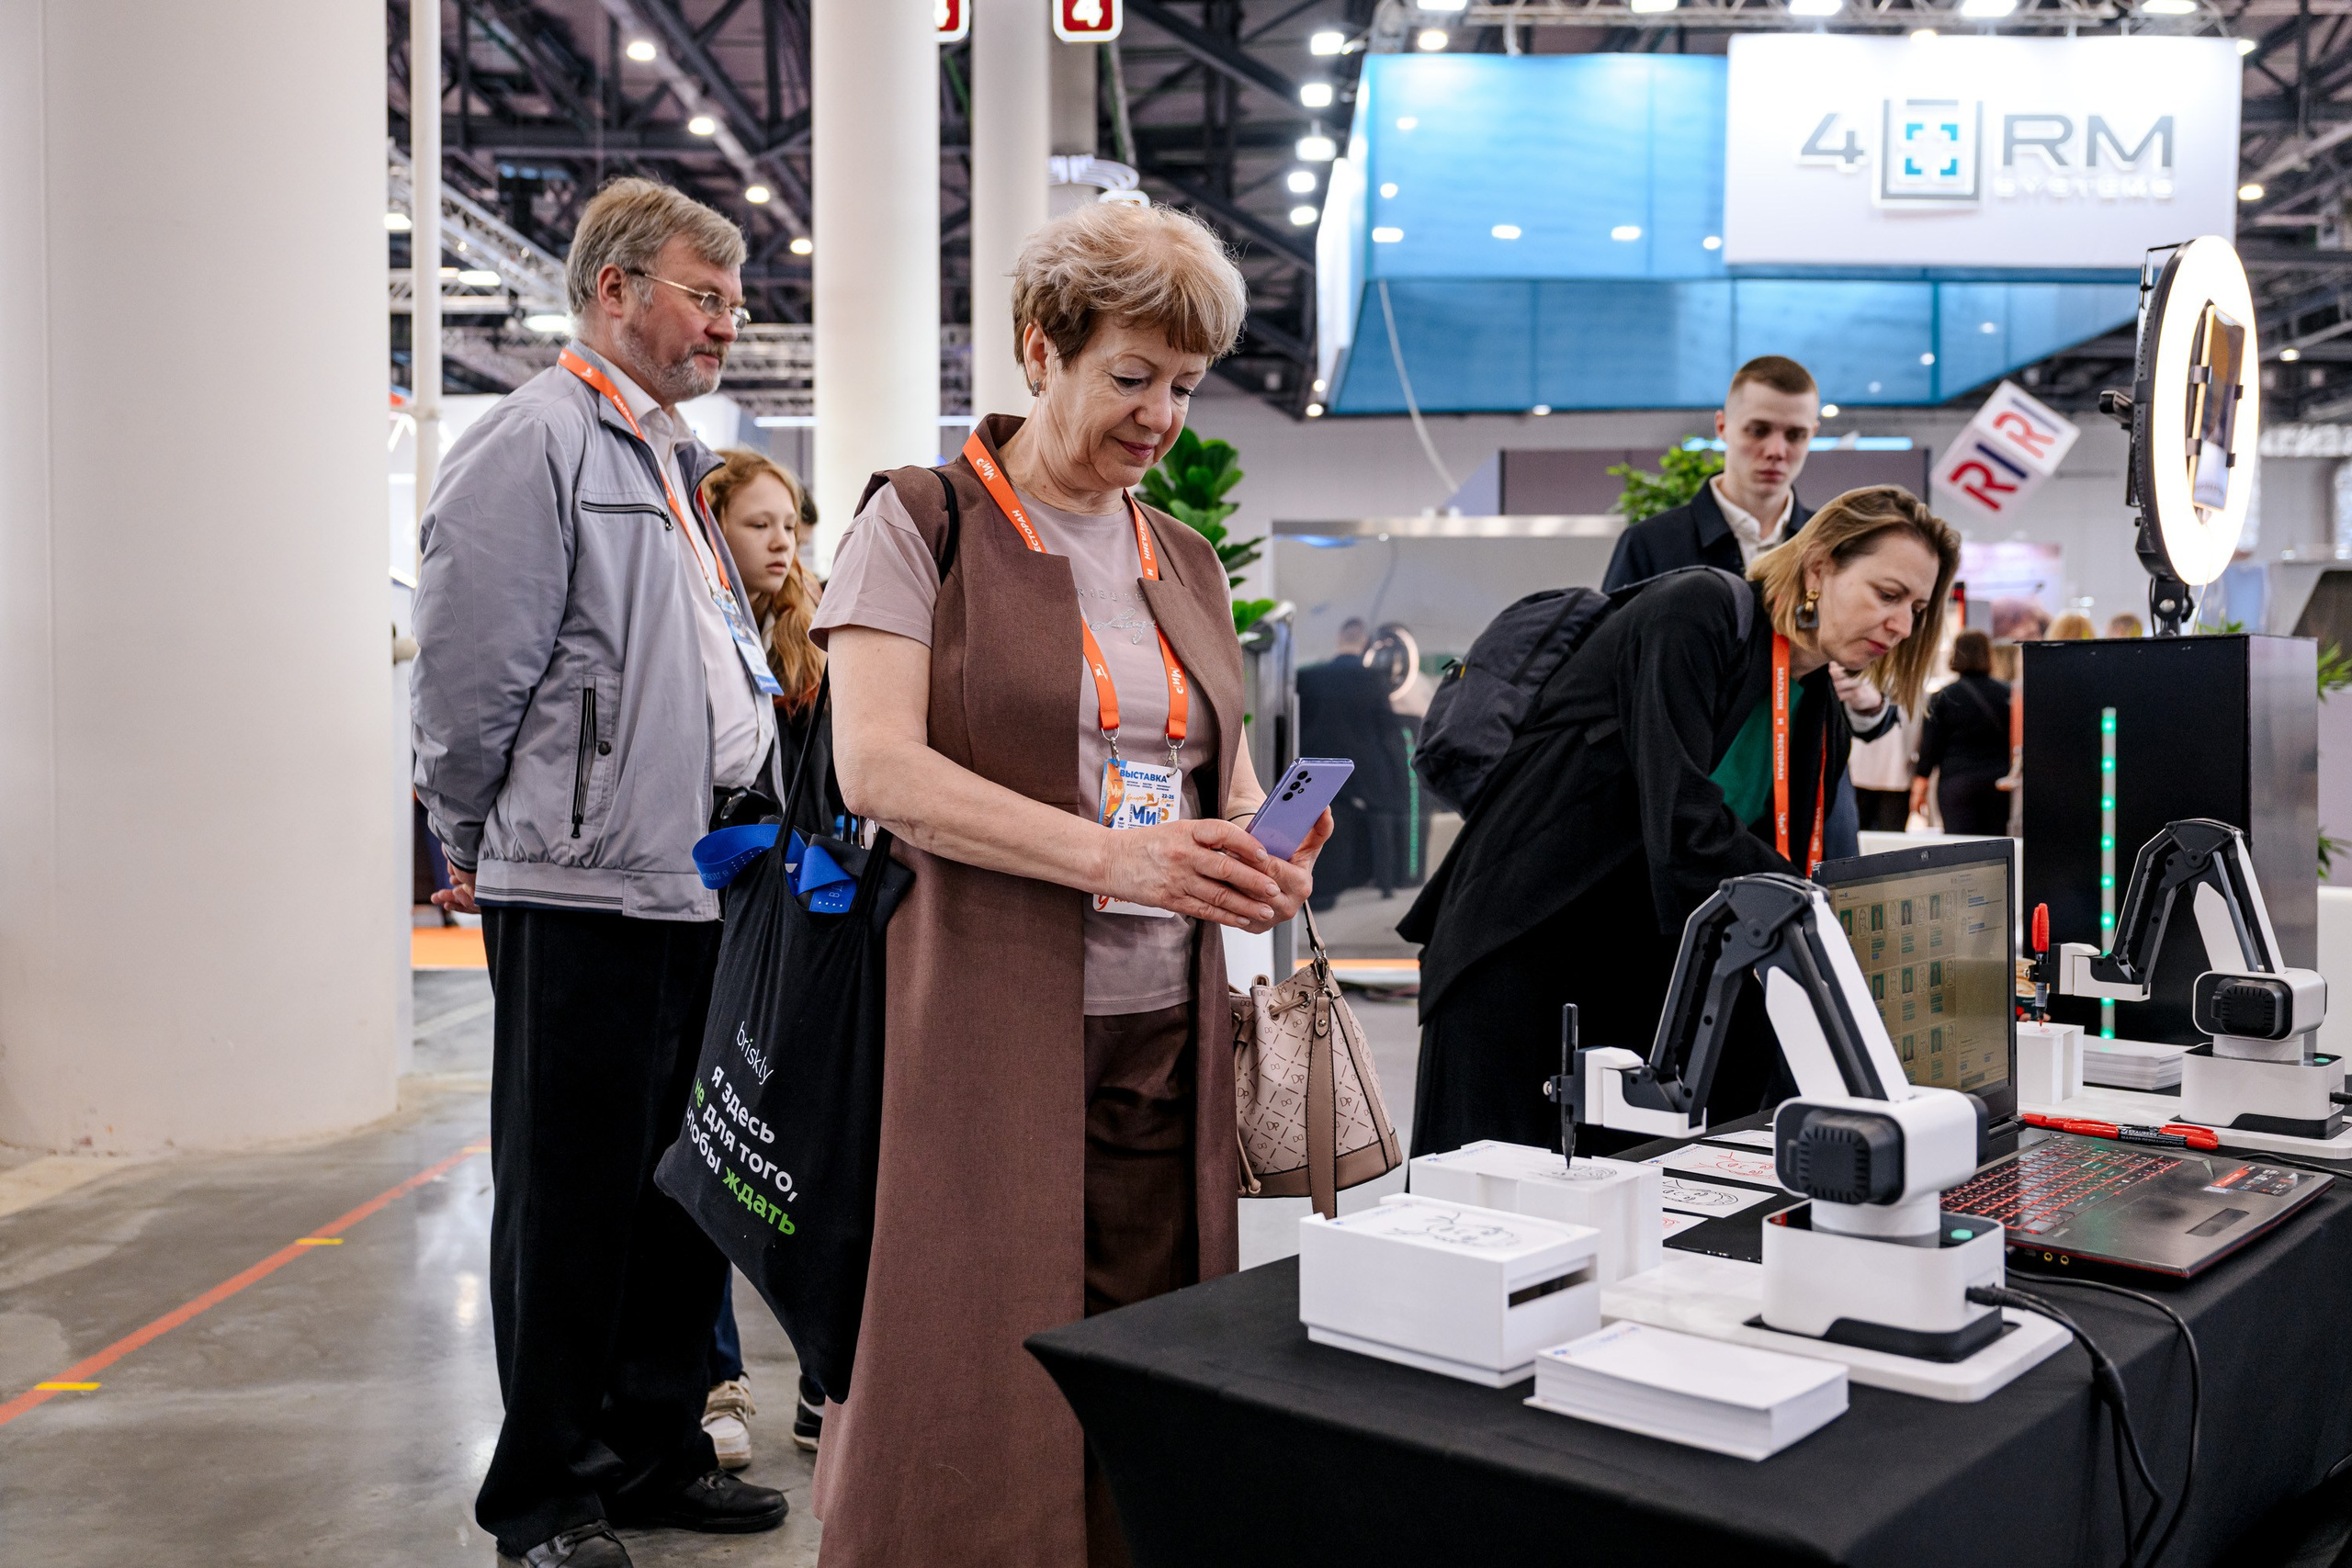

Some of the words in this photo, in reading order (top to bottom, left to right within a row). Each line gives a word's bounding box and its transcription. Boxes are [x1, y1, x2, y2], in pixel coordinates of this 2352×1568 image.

[1994, 175, 2175, 198] SYSTEMS
[1012, 509, 1043, 552] ЕСТОРАН
[1137, 516, 1151, 560] МАГАЗИН
[1777, 667, 1785, 710] МАГАЗИН
[1119, 769, 1168, 784] ВЫСТАВКА
[1777, 733, 1785, 781] РЕСТОРАН
[736, 1021, 775, 1086] briskly
[722, 1082, 775, 1145] здесь
[695, 1077, 706, 1109] не
[703, 1104, 736, 1153] для
[740, 1143, 798, 1202] того,
[686, 1105, 722, 1175] чтобы
[722, 1166, 797, 1236] ждать
